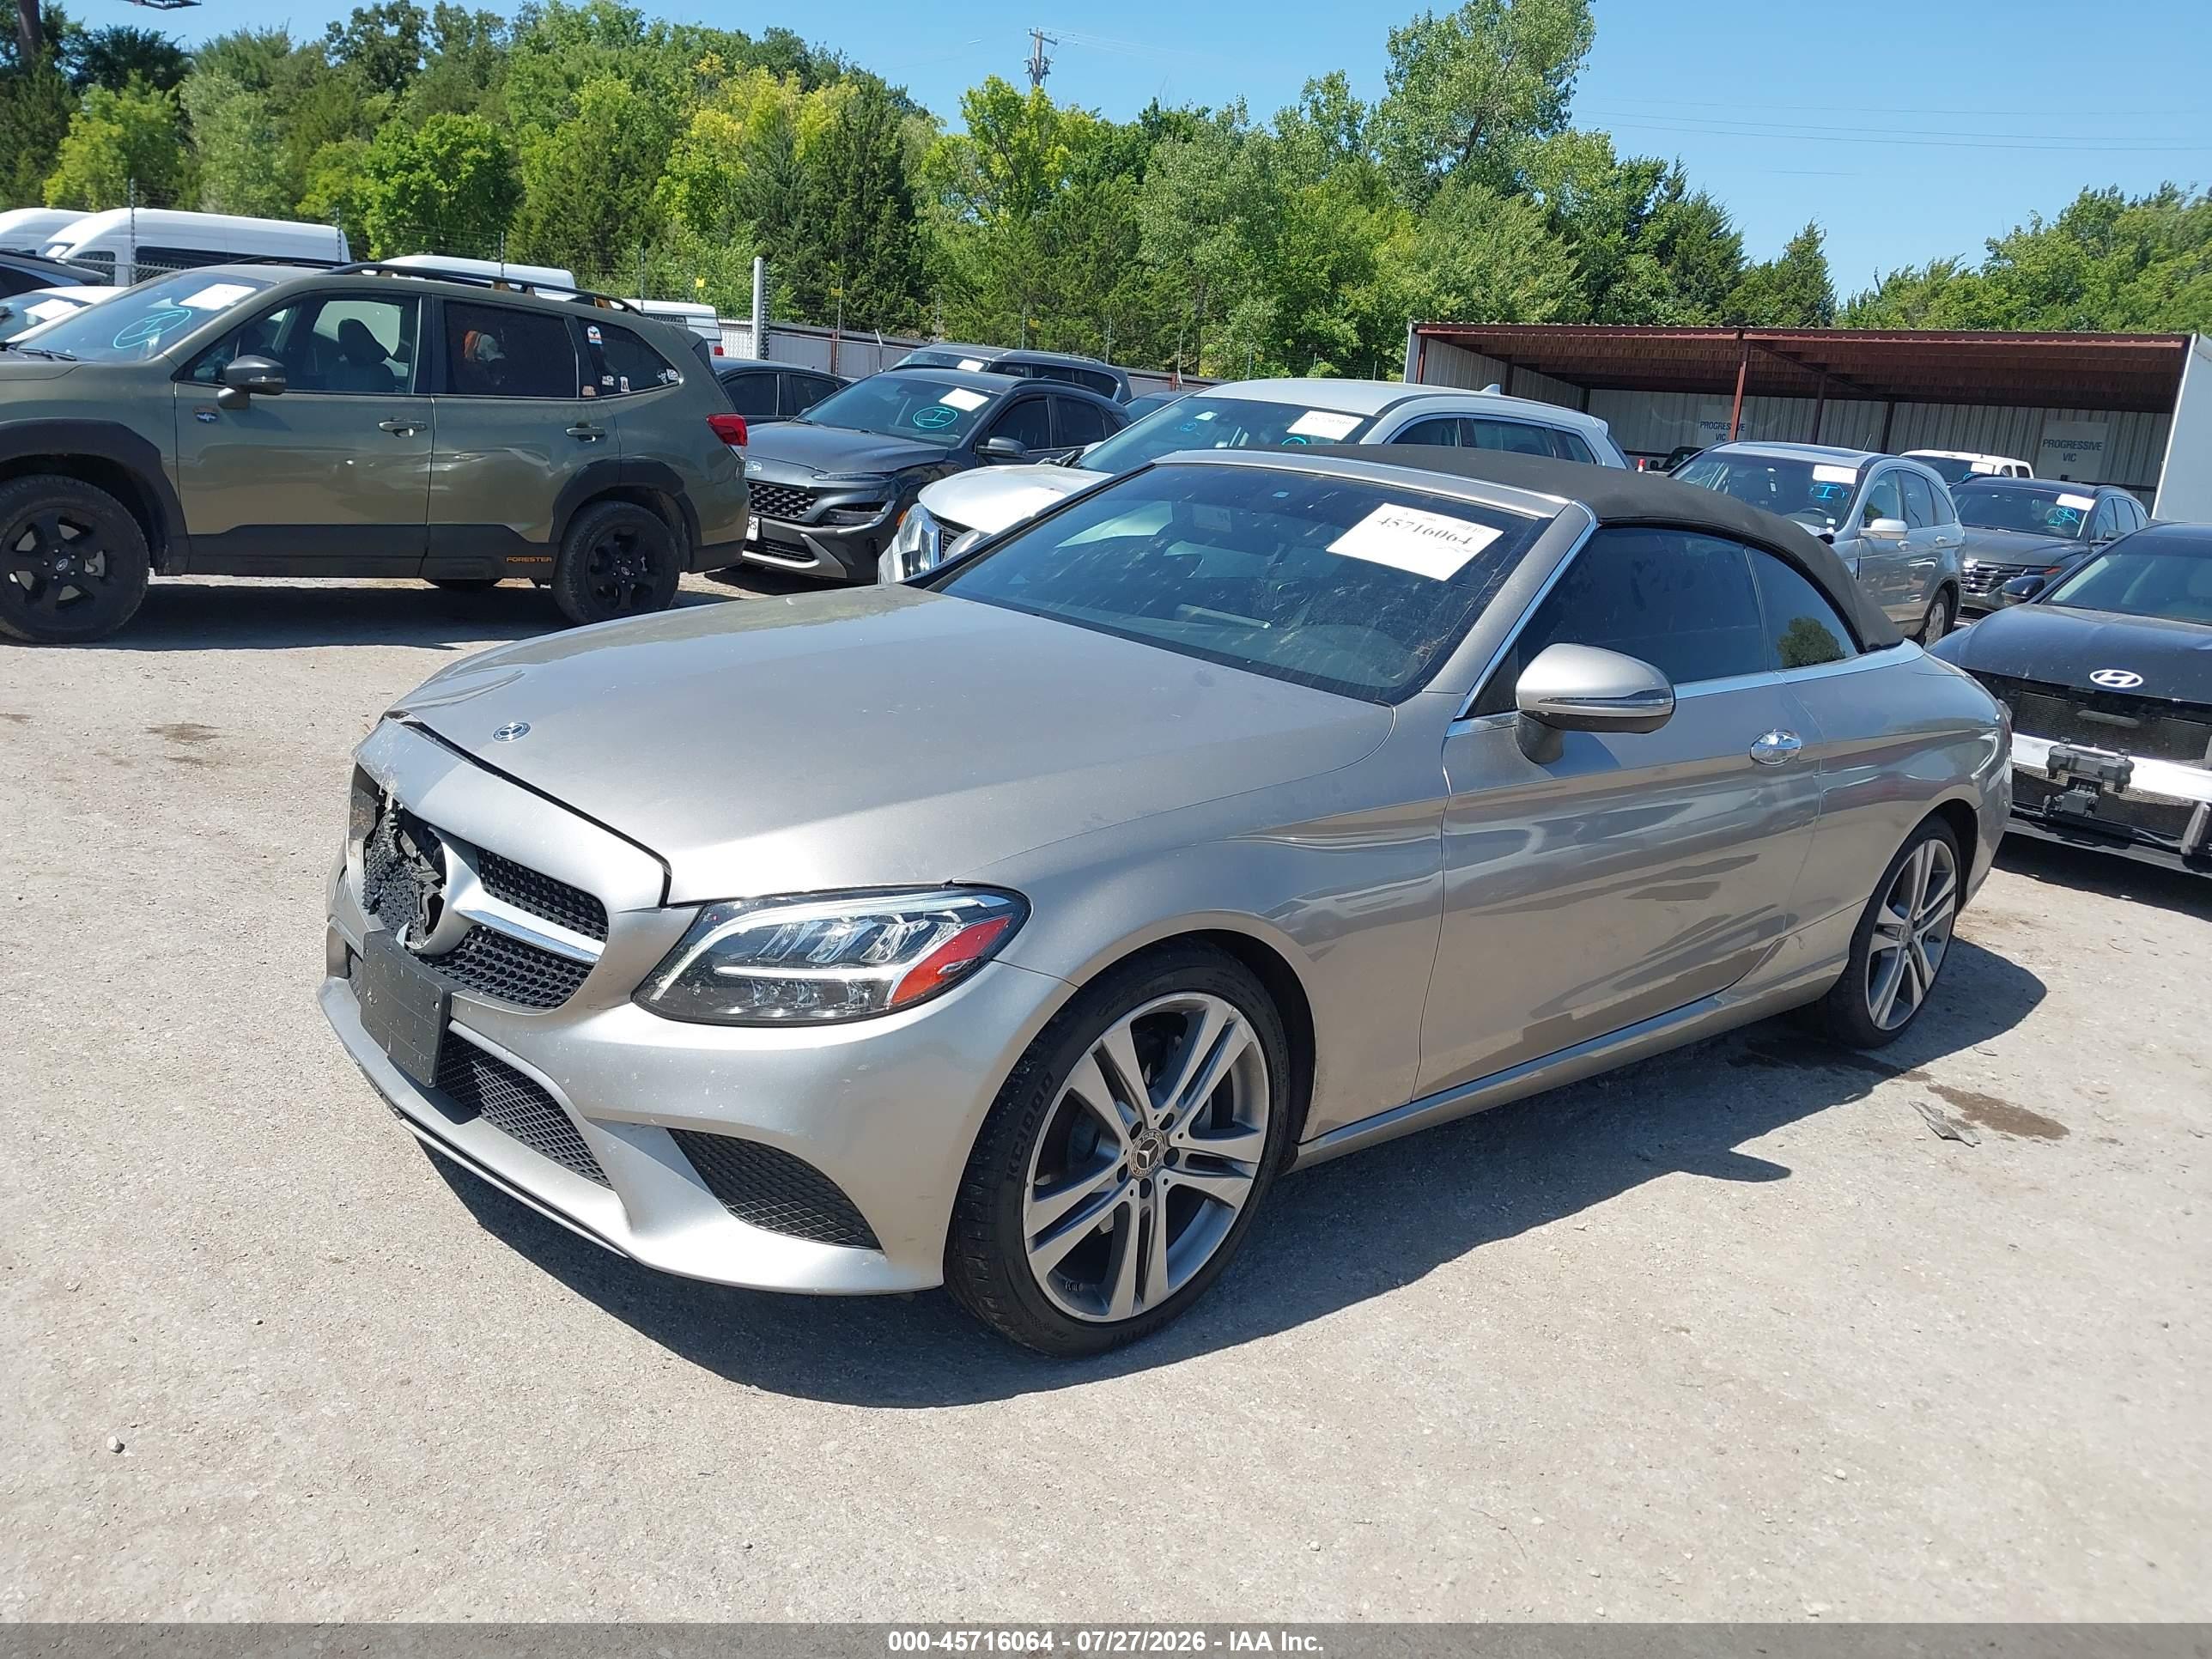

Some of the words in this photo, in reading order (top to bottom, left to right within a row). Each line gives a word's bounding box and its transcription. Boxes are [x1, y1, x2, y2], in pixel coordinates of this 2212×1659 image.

[1700, 421, 1745, 431] PROGRESVE
[2043, 439, 2102, 451] PROGRESSIVE
[2063, 453, 2076, 462] VIC
[1376, 517, 1473, 544] 45716064
